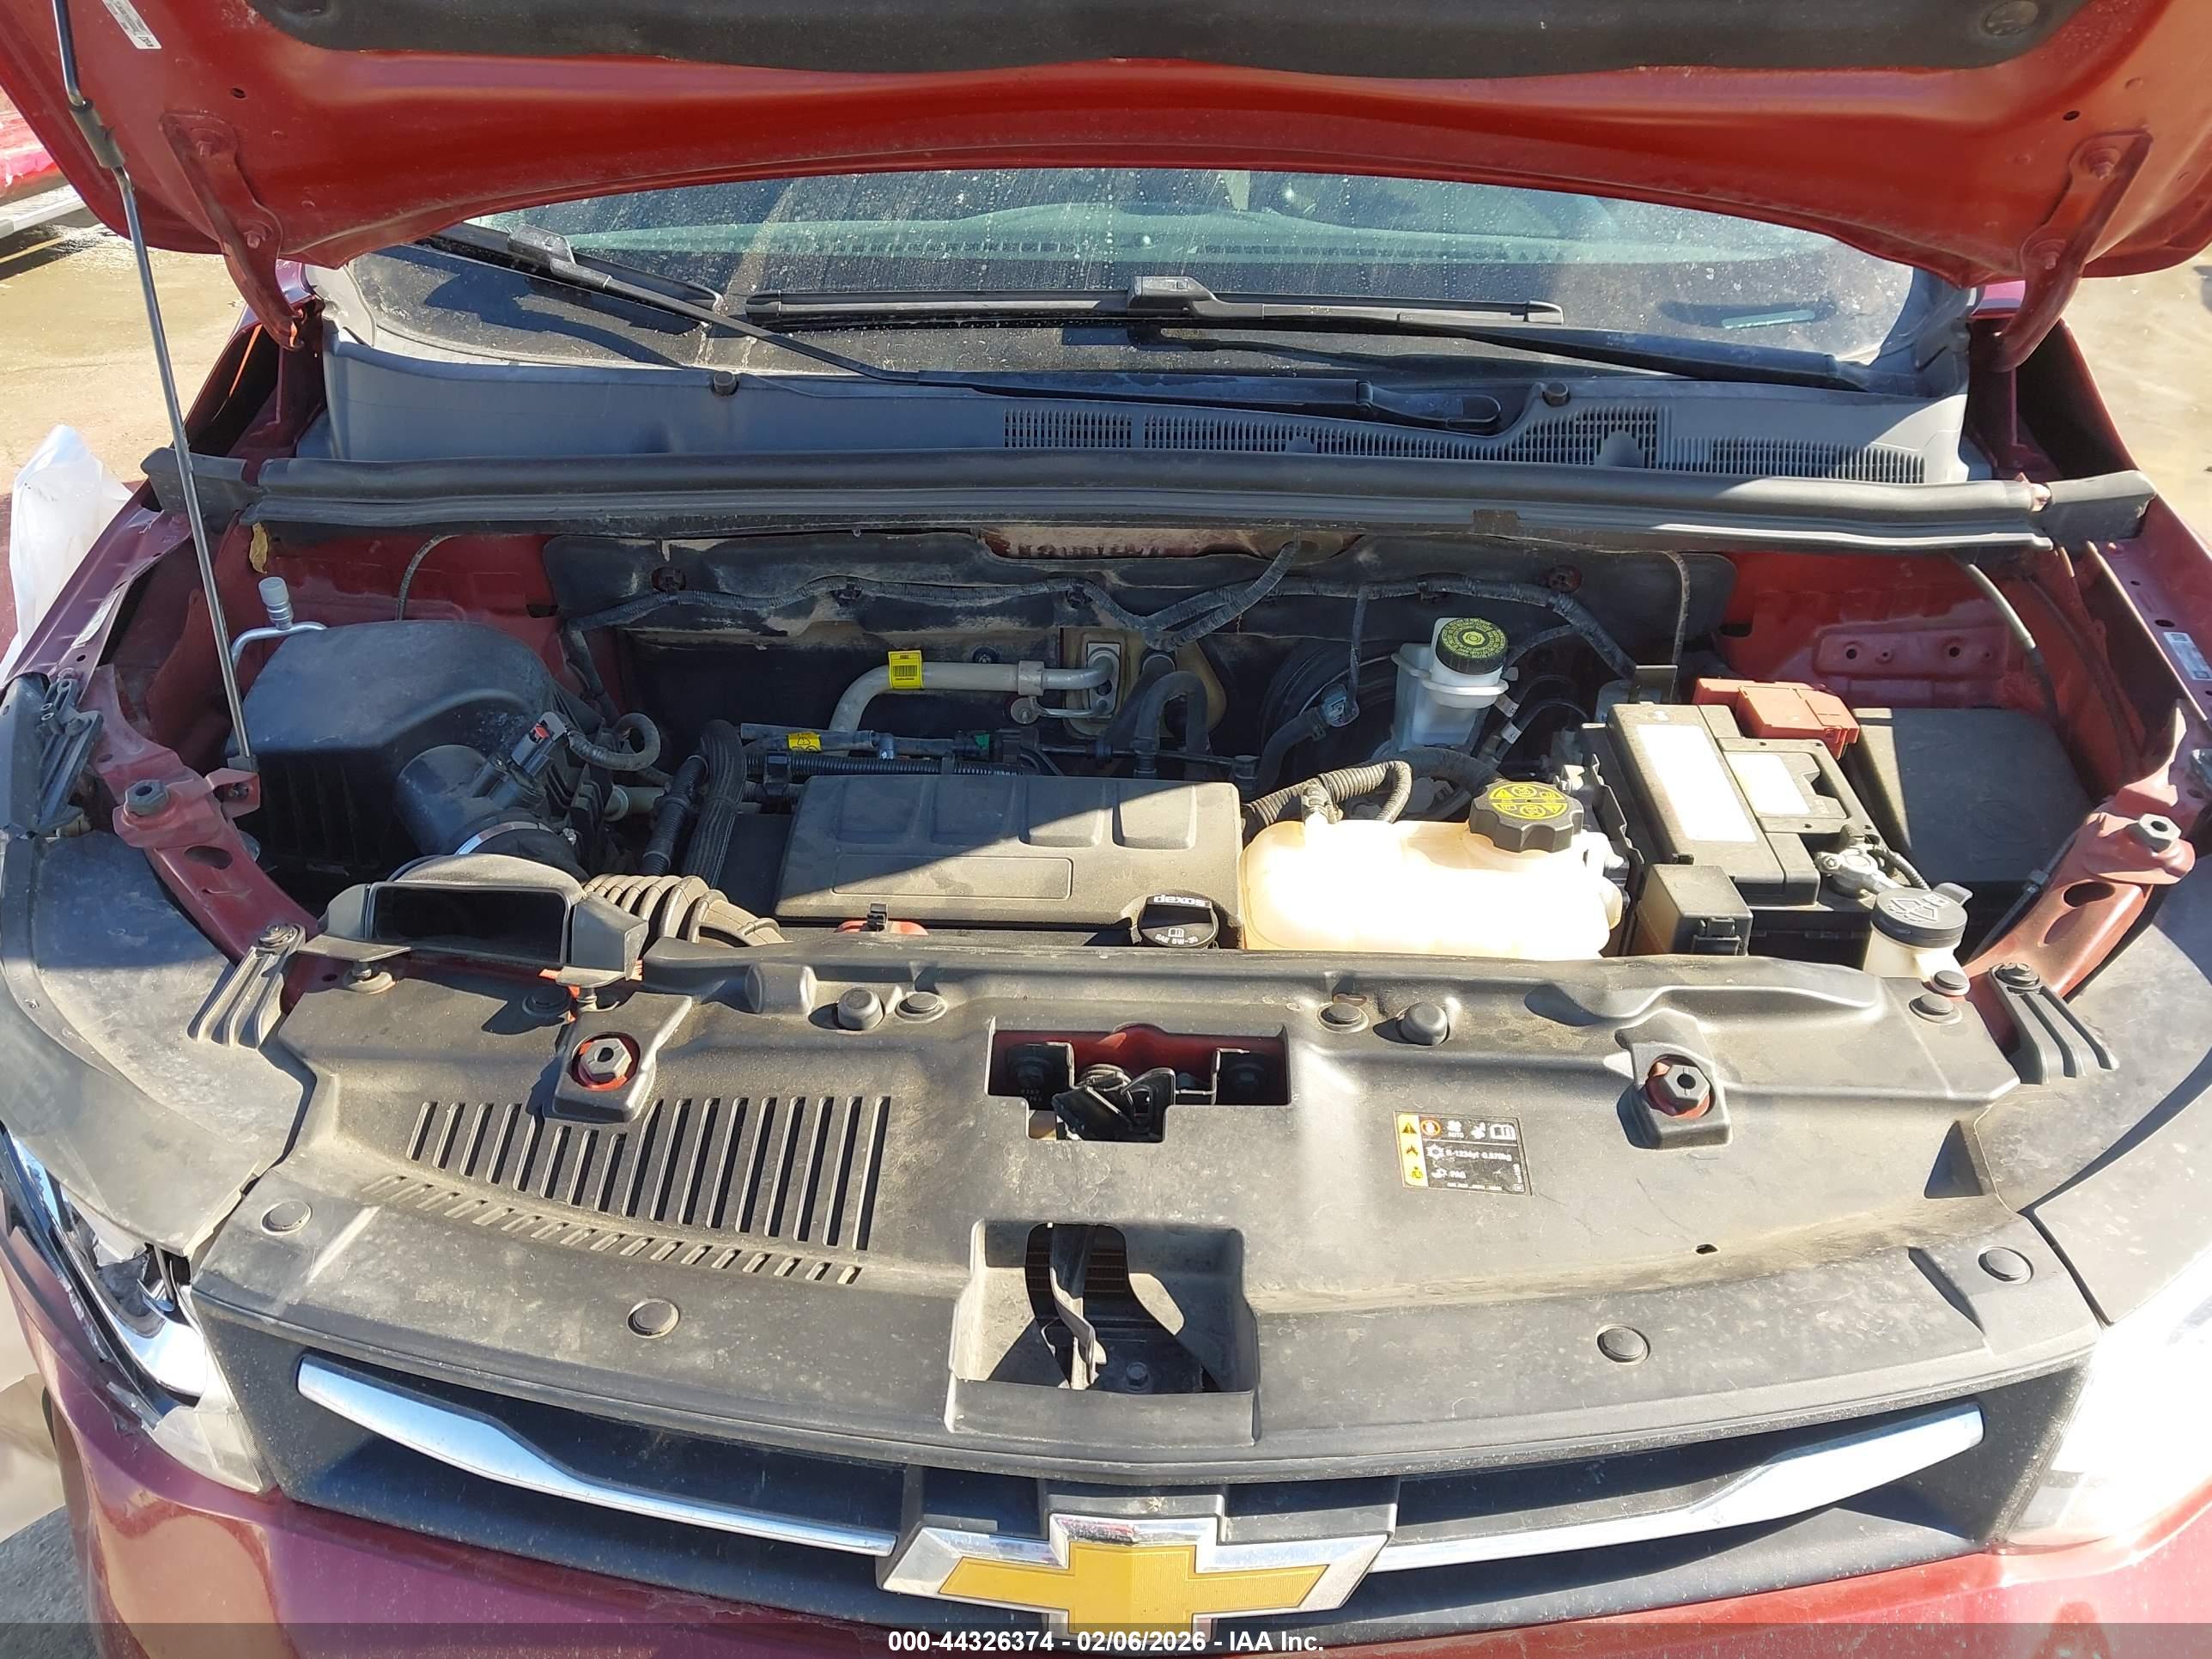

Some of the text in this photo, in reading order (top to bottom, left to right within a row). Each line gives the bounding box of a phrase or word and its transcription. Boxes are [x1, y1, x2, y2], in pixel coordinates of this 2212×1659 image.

[1153, 894, 1206, 907] dexos
[1155, 934, 1199, 945] SAE 5W-30
